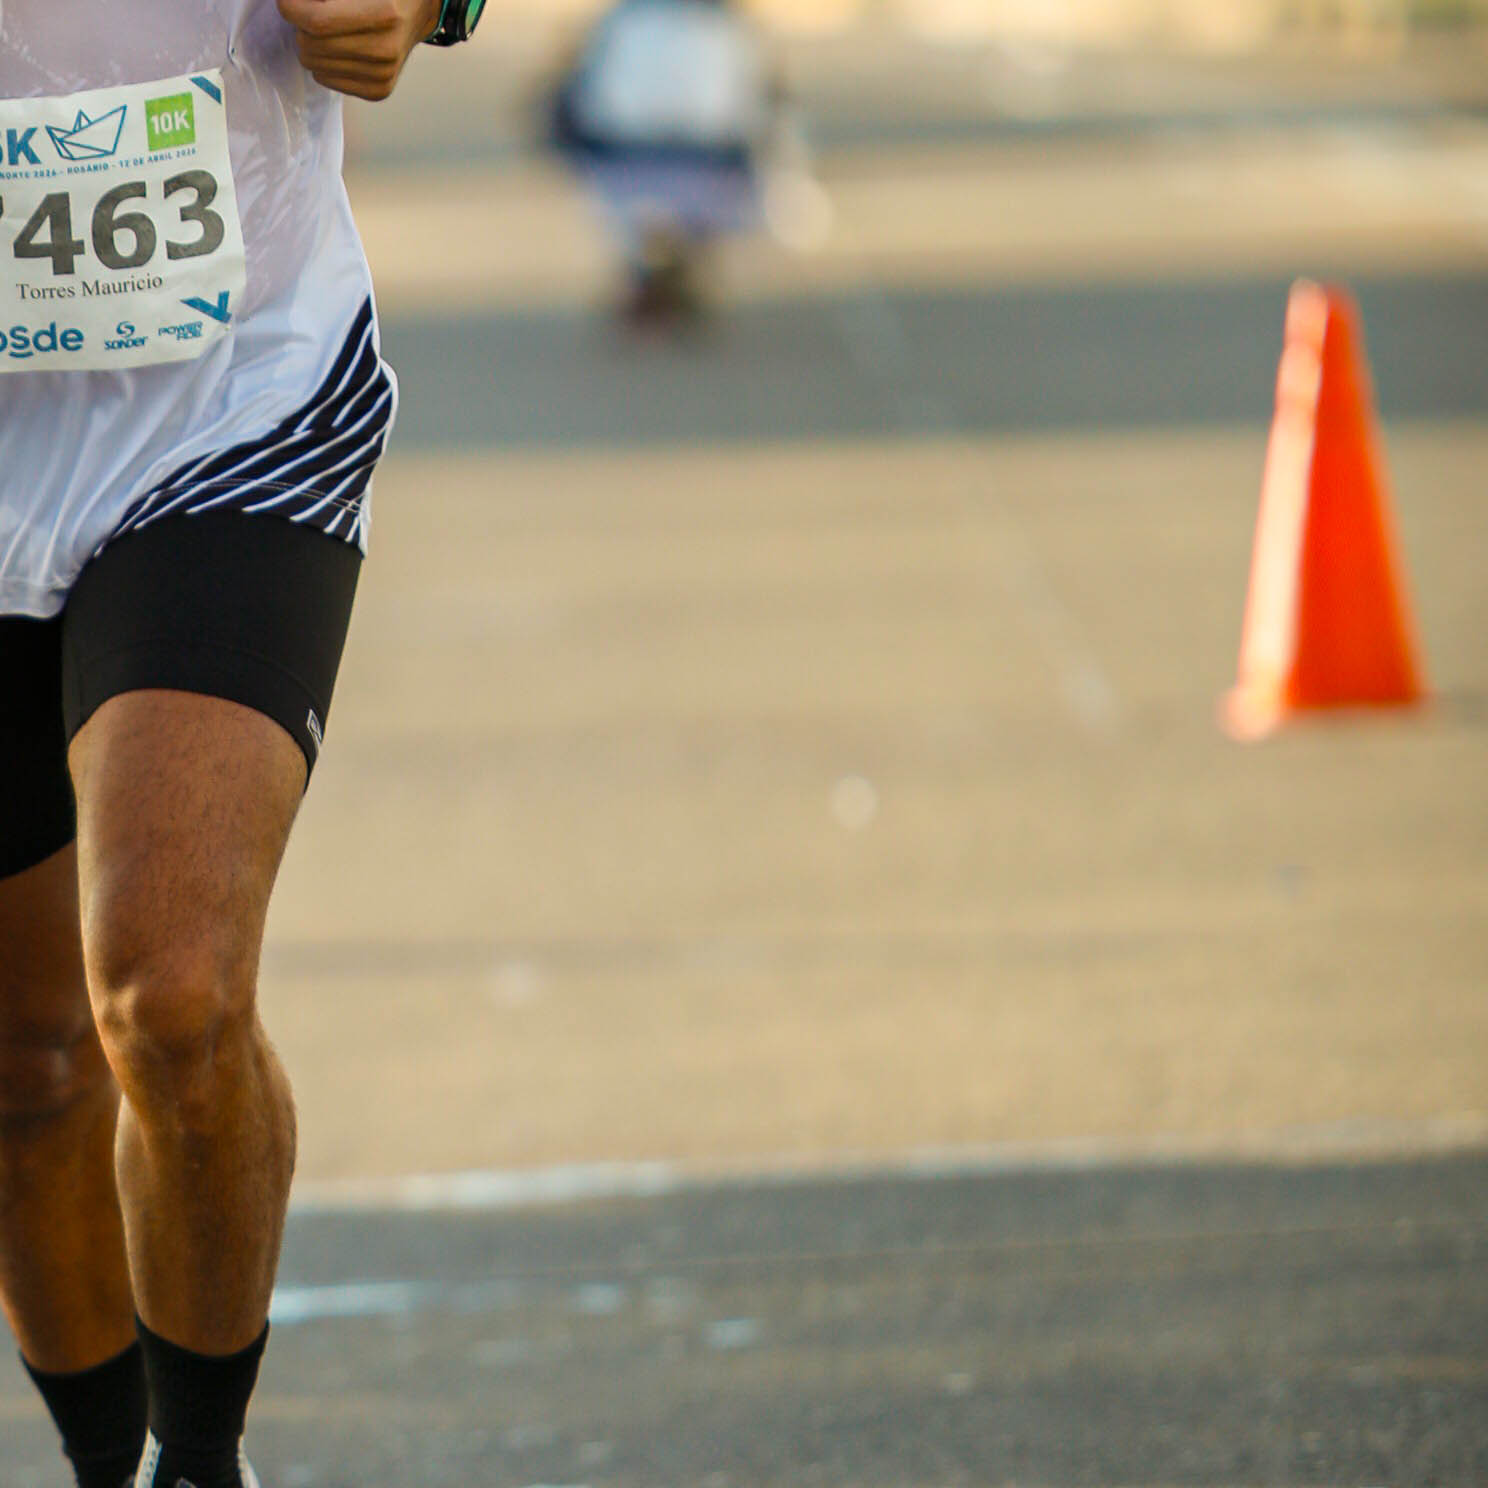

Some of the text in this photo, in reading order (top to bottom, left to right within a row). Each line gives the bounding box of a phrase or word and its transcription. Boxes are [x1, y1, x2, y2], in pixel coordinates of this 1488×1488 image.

[150, 109, 191, 136] 10K
[0, 170, 29, 180] NORTE
[133, 157, 145, 167] DE
[147, 151, 173, 164] ABRIL
[16, 273, 163, 300] Torres Mauricio
